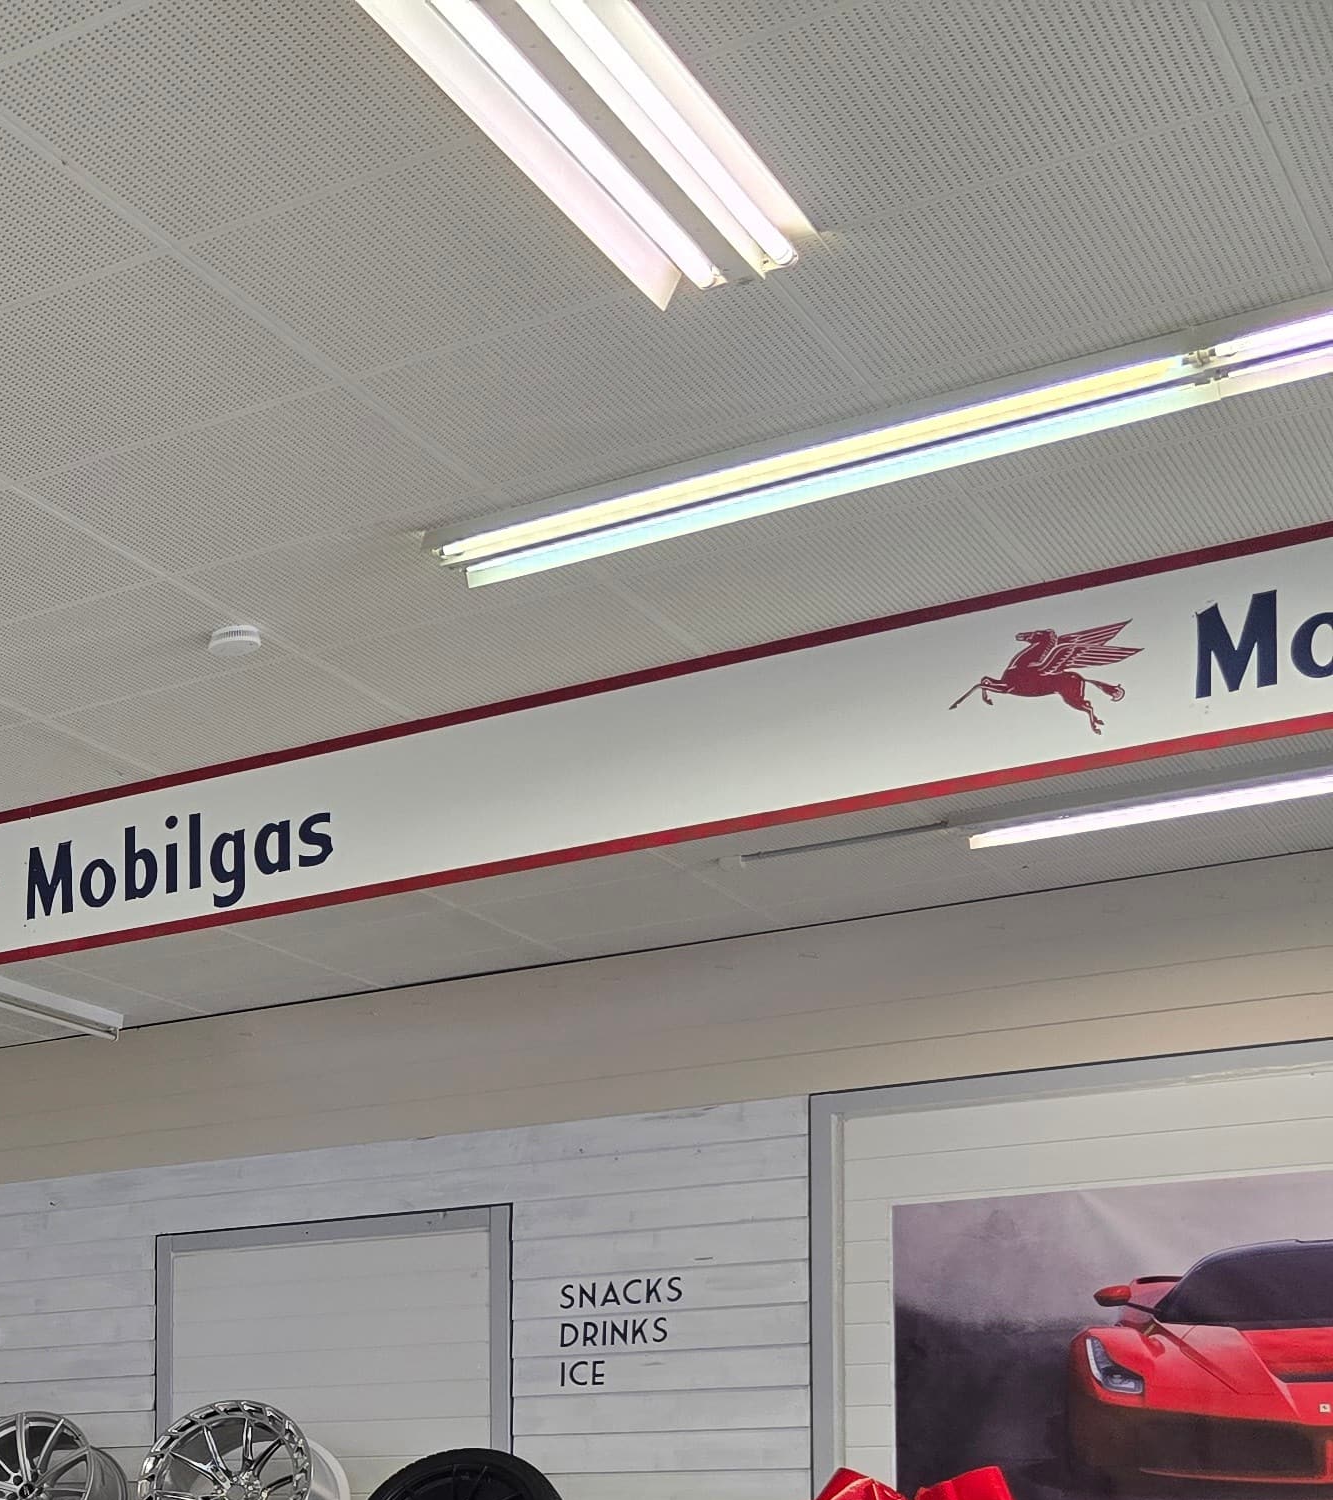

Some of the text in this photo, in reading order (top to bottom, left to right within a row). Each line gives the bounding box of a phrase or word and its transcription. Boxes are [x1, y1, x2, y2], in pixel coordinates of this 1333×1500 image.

[1195, 589, 1333, 699] Mo
[26, 812, 334, 920] Mobilgas
[559, 1276, 683, 1309] SNACKS
[559, 1316, 668, 1348] DRINKS
[559, 1360, 606, 1387] ICE
